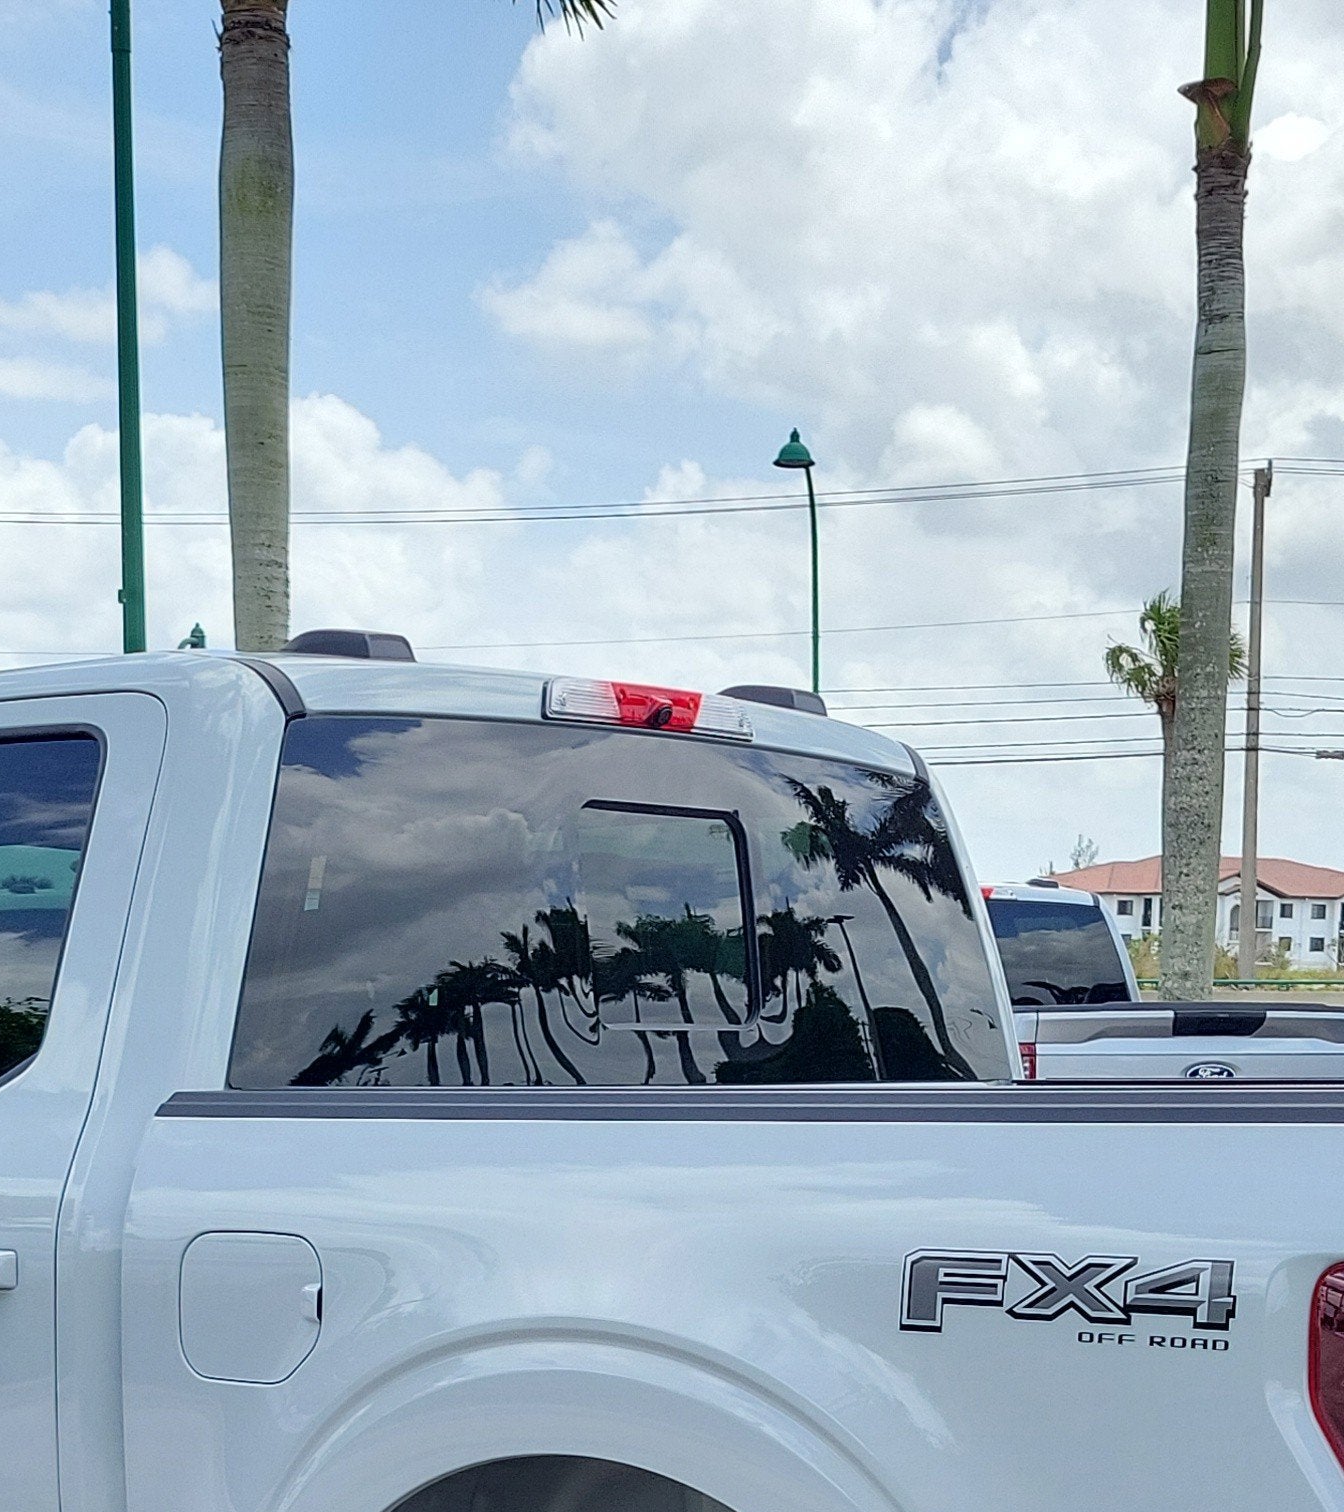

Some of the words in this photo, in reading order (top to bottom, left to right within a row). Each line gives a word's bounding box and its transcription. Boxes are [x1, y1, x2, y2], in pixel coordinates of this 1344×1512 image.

[899, 1247, 1236, 1333] FX4
[1077, 1330, 1136, 1346] OFF
[1148, 1334, 1230, 1352] ROAD
